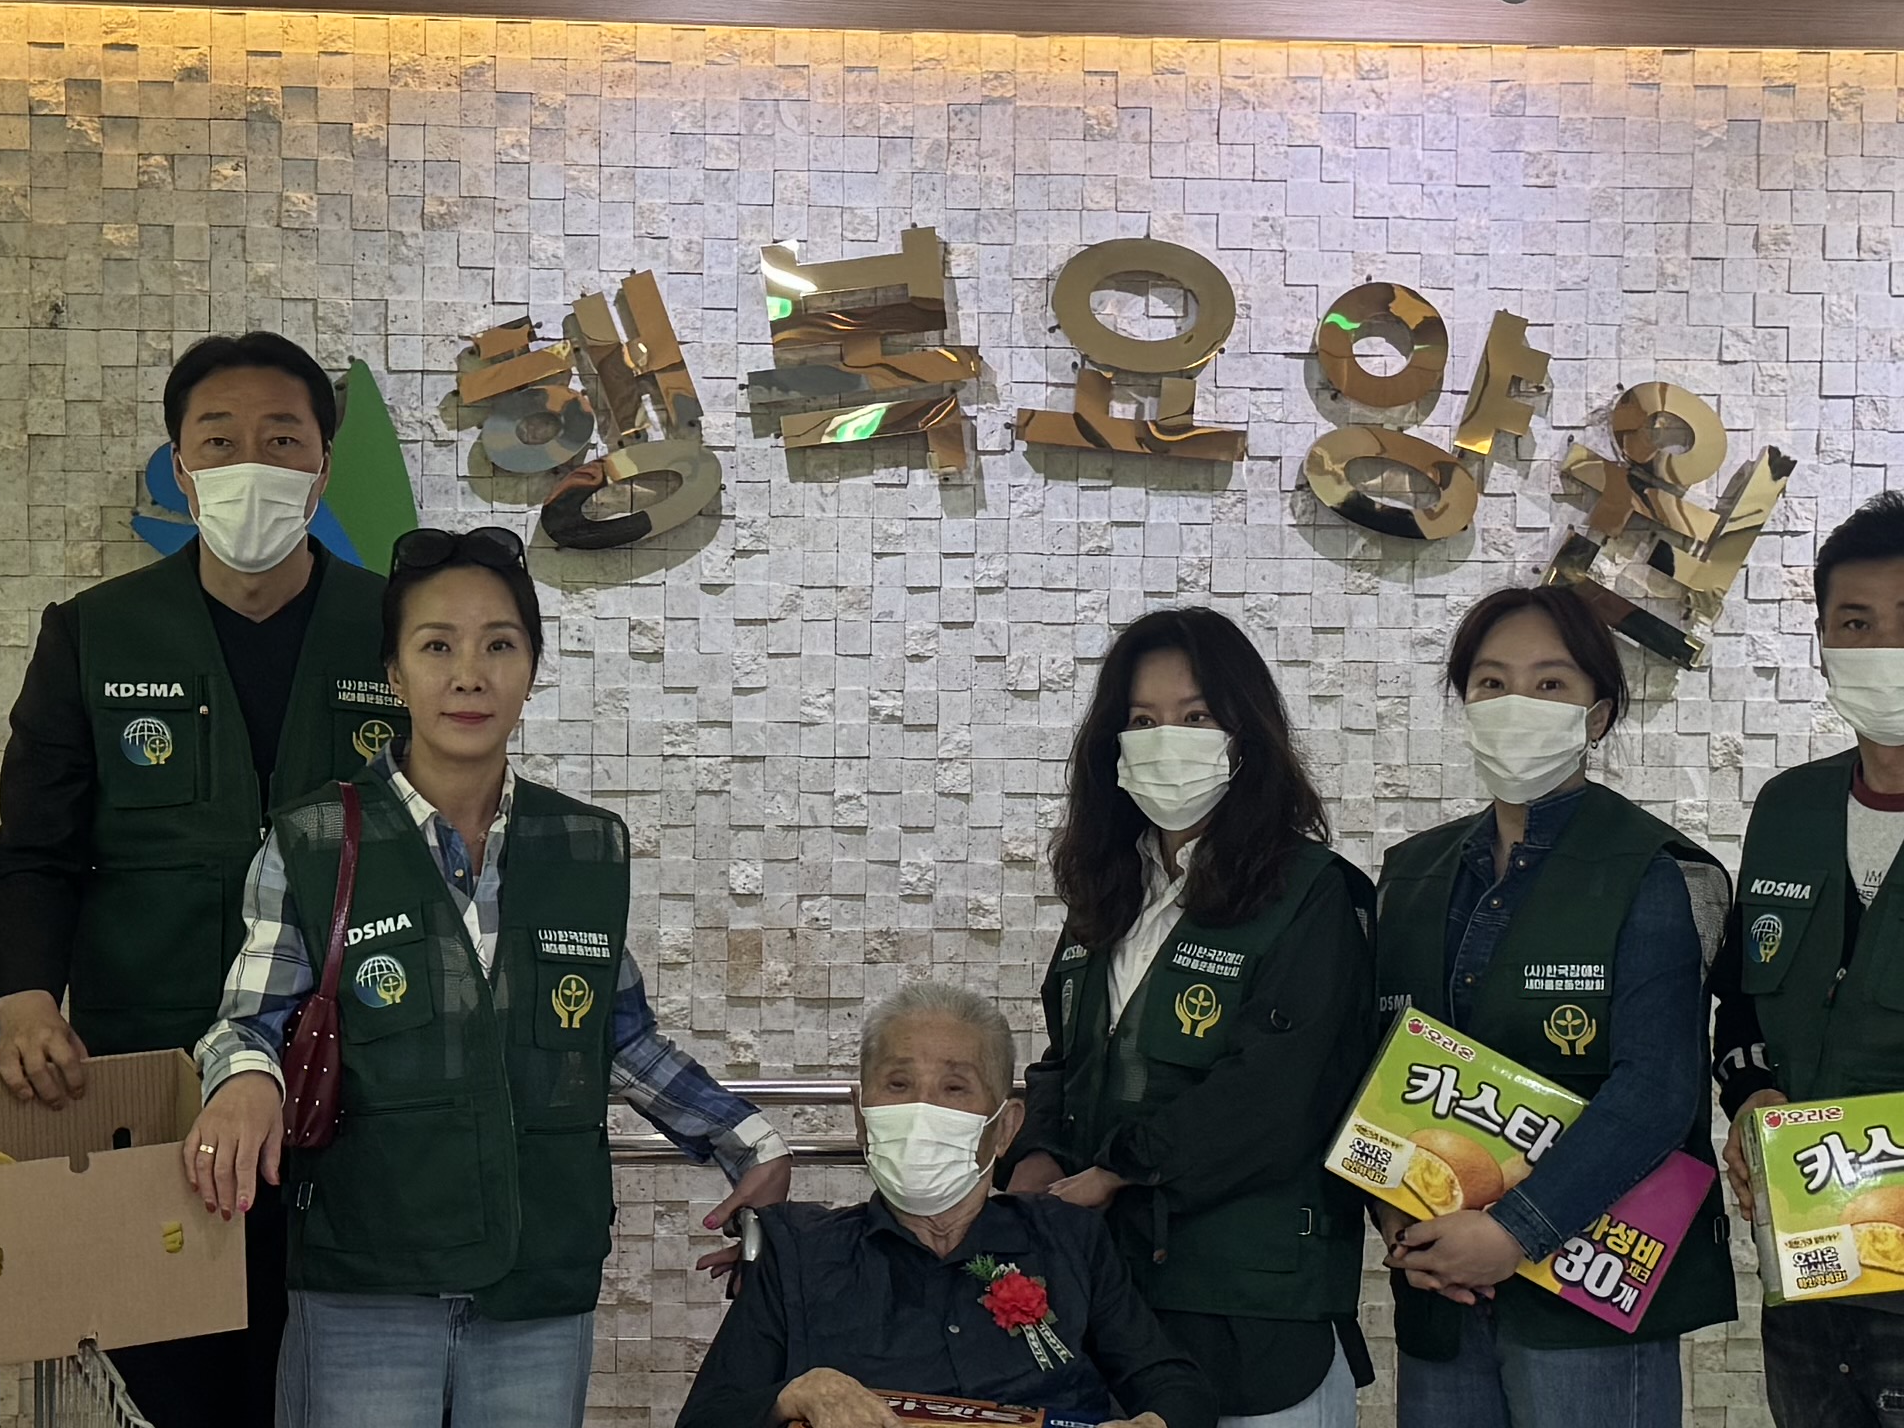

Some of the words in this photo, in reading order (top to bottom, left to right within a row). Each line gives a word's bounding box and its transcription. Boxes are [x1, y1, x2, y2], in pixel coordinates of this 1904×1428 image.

[459, 223, 1798, 670] 행복요양원
[104, 681, 184, 698] KDSMA
[1750, 878, 1812, 901] KDSMA
[344, 913, 413, 947] DSMA
[1379, 994, 1413, 1012] DSMA
[1403, 1064, 1564, 1164] 카스타
[1786, 1107, 1843, 1123] 오리온
